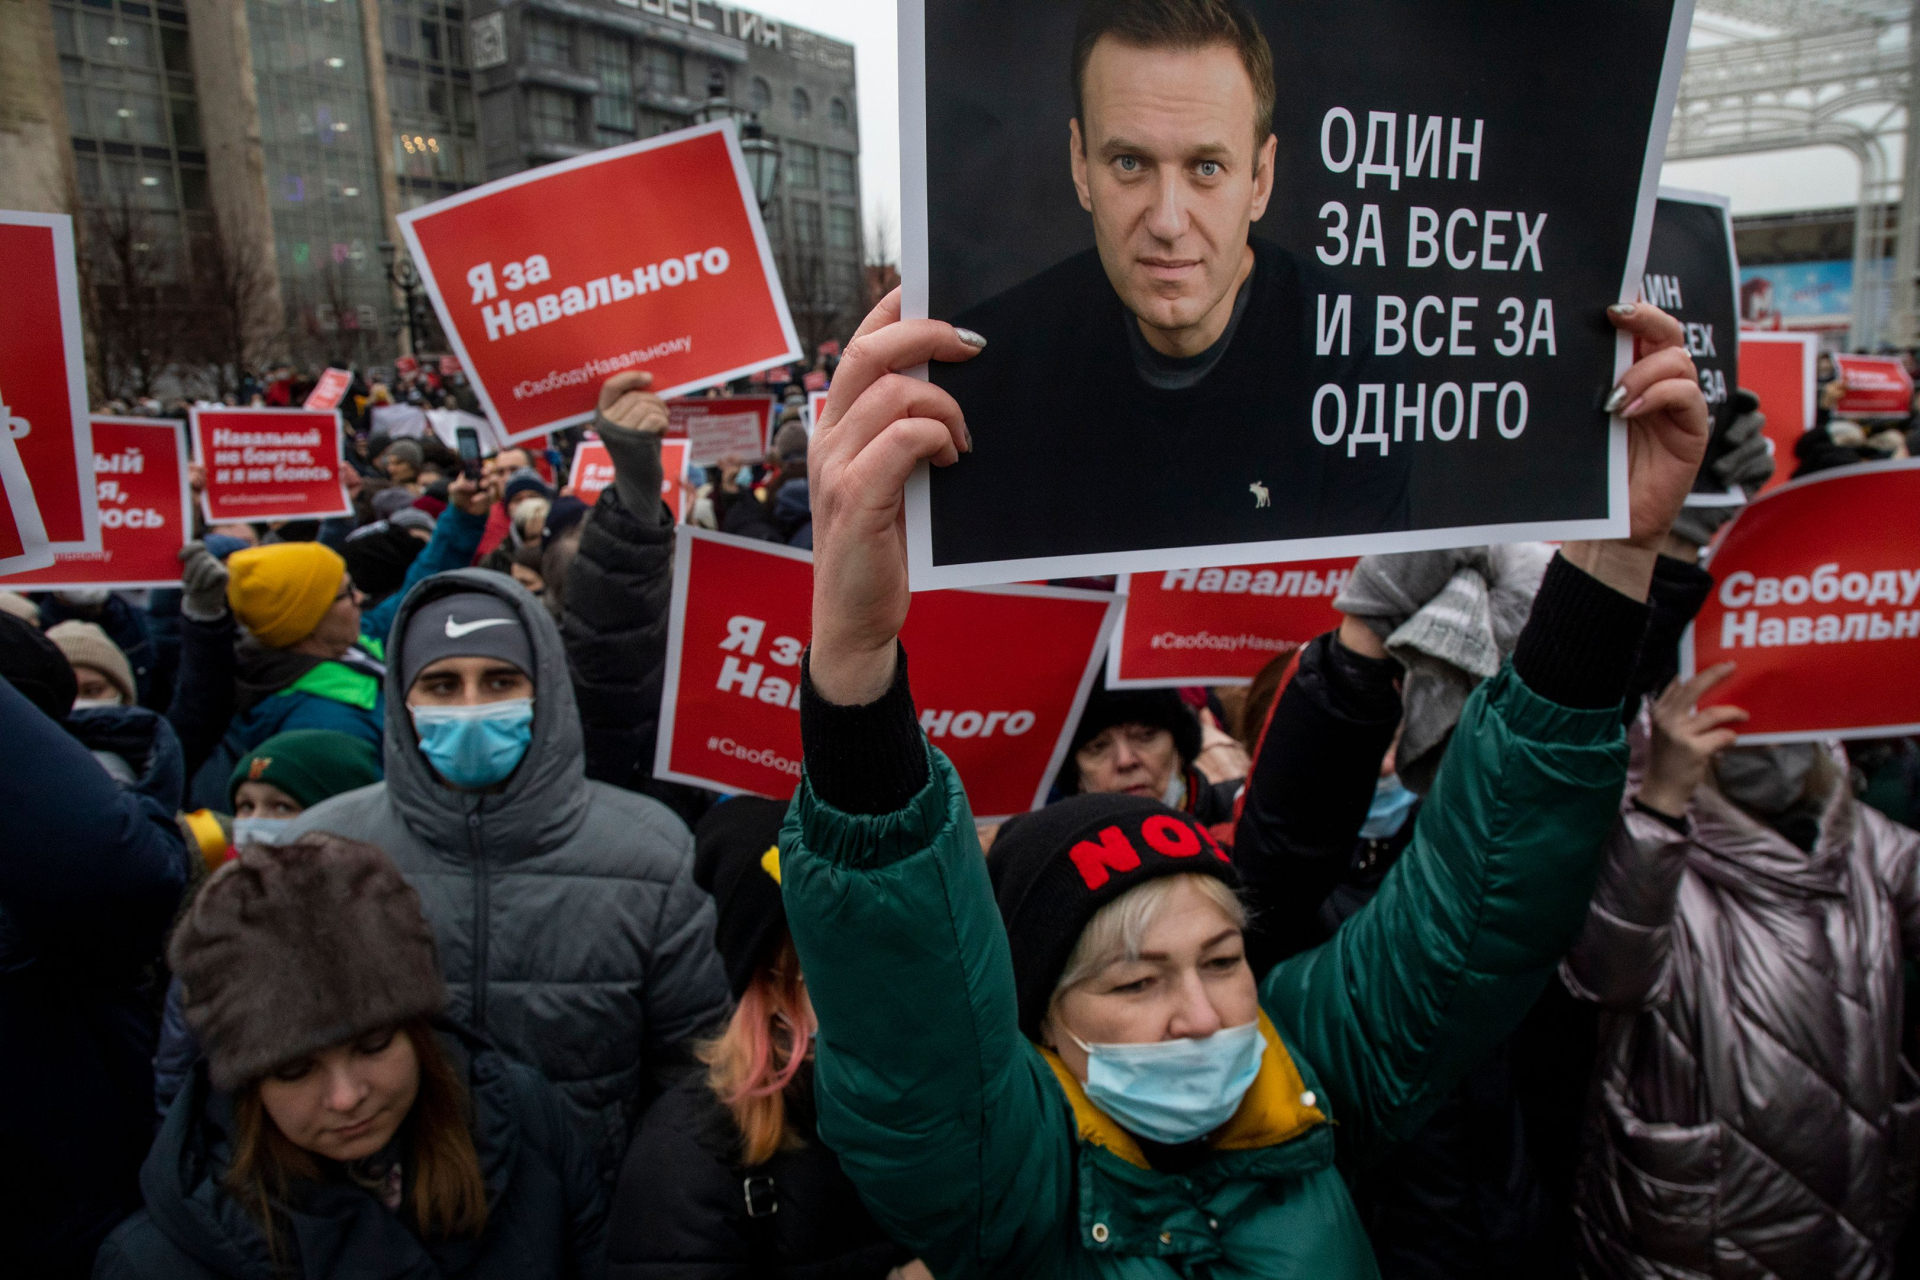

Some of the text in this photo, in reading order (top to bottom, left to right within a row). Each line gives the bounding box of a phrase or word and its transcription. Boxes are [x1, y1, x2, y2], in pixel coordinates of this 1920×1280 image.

[1321, 107, 1483, 190] ОДИН
[1316, 201, 1547, 271] ЗА ВСЕХ
[467, 254, 550, 304] Я за
[481, 246, 729, 341] Навального
[1316, 294, 1556, 356] И ВСЕ ЗА
[512, 335, 692, 400] #СвободуНавальному
[1312, 381, 1528, 457] ОДНОГО
[1719, 562, 1920, 608] Свободу
[718, 615, 805, 668] Я з
